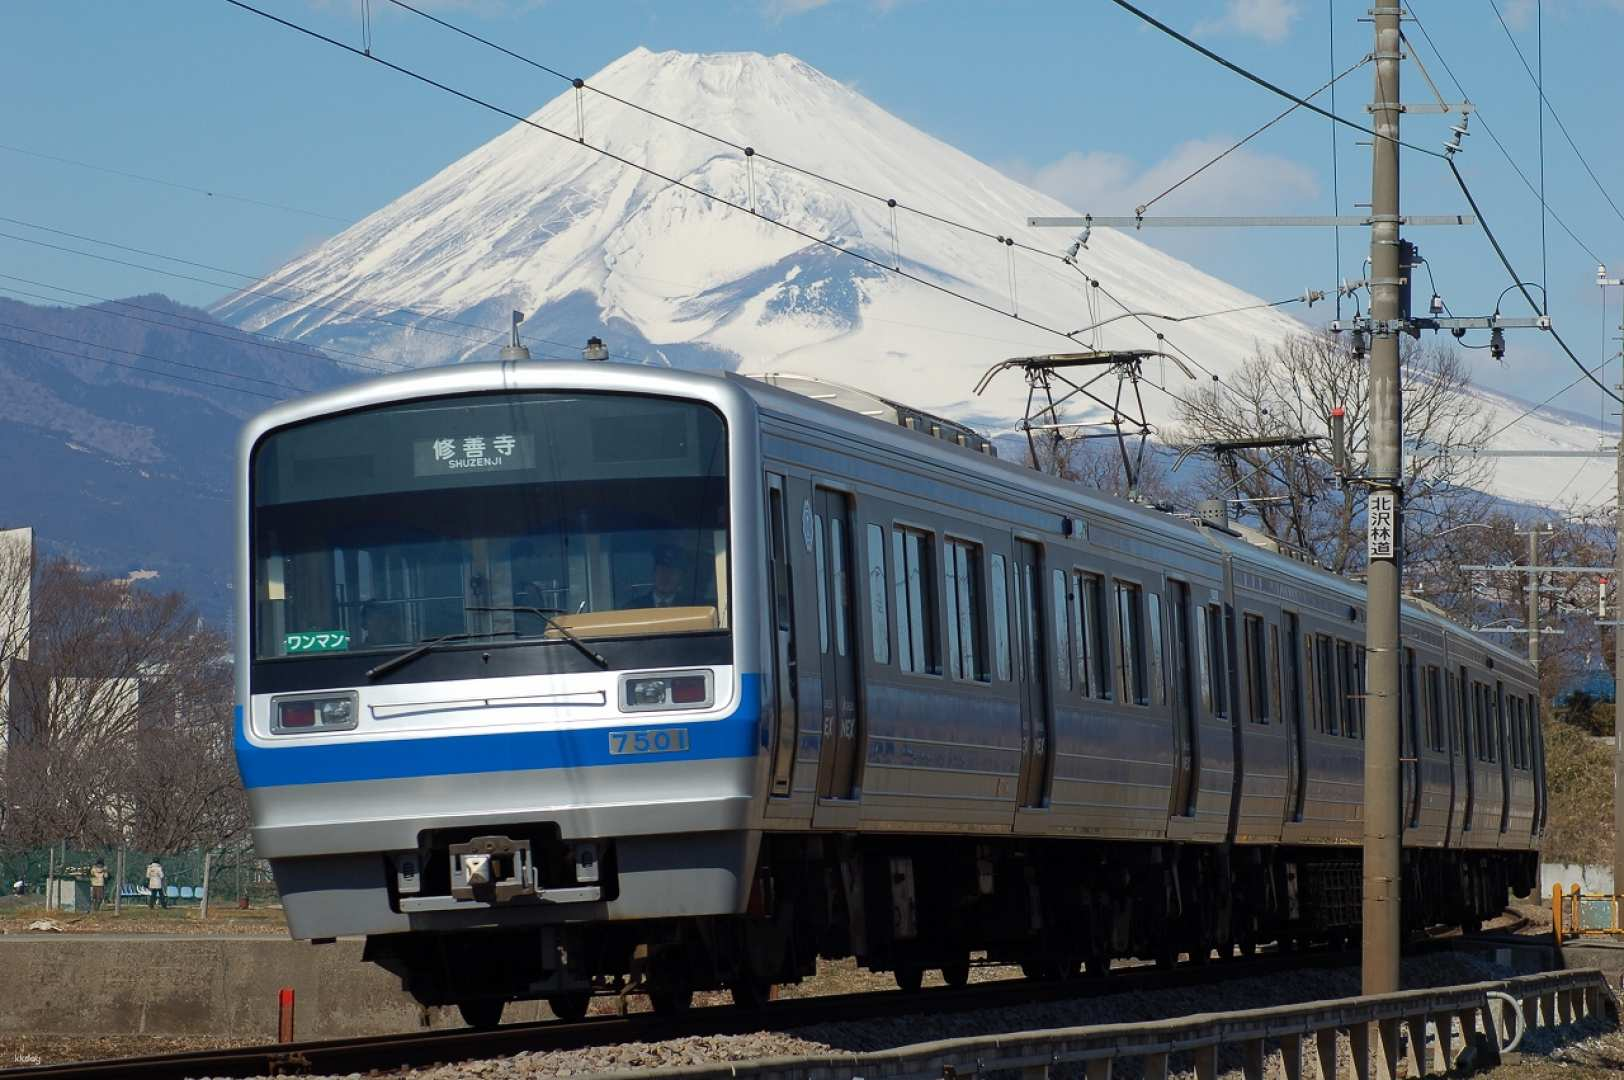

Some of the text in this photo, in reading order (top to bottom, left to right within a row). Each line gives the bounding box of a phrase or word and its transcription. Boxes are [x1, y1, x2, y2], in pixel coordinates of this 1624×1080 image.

[433, 434, 516, 460] 修善寺
[448, 457, 502, 468] SHUZENJI
[1371, 496, 1391, 555] 北沢林道
[288, 634, 344, 650] ワンマン
[612, 730, 687, 753] 7501
